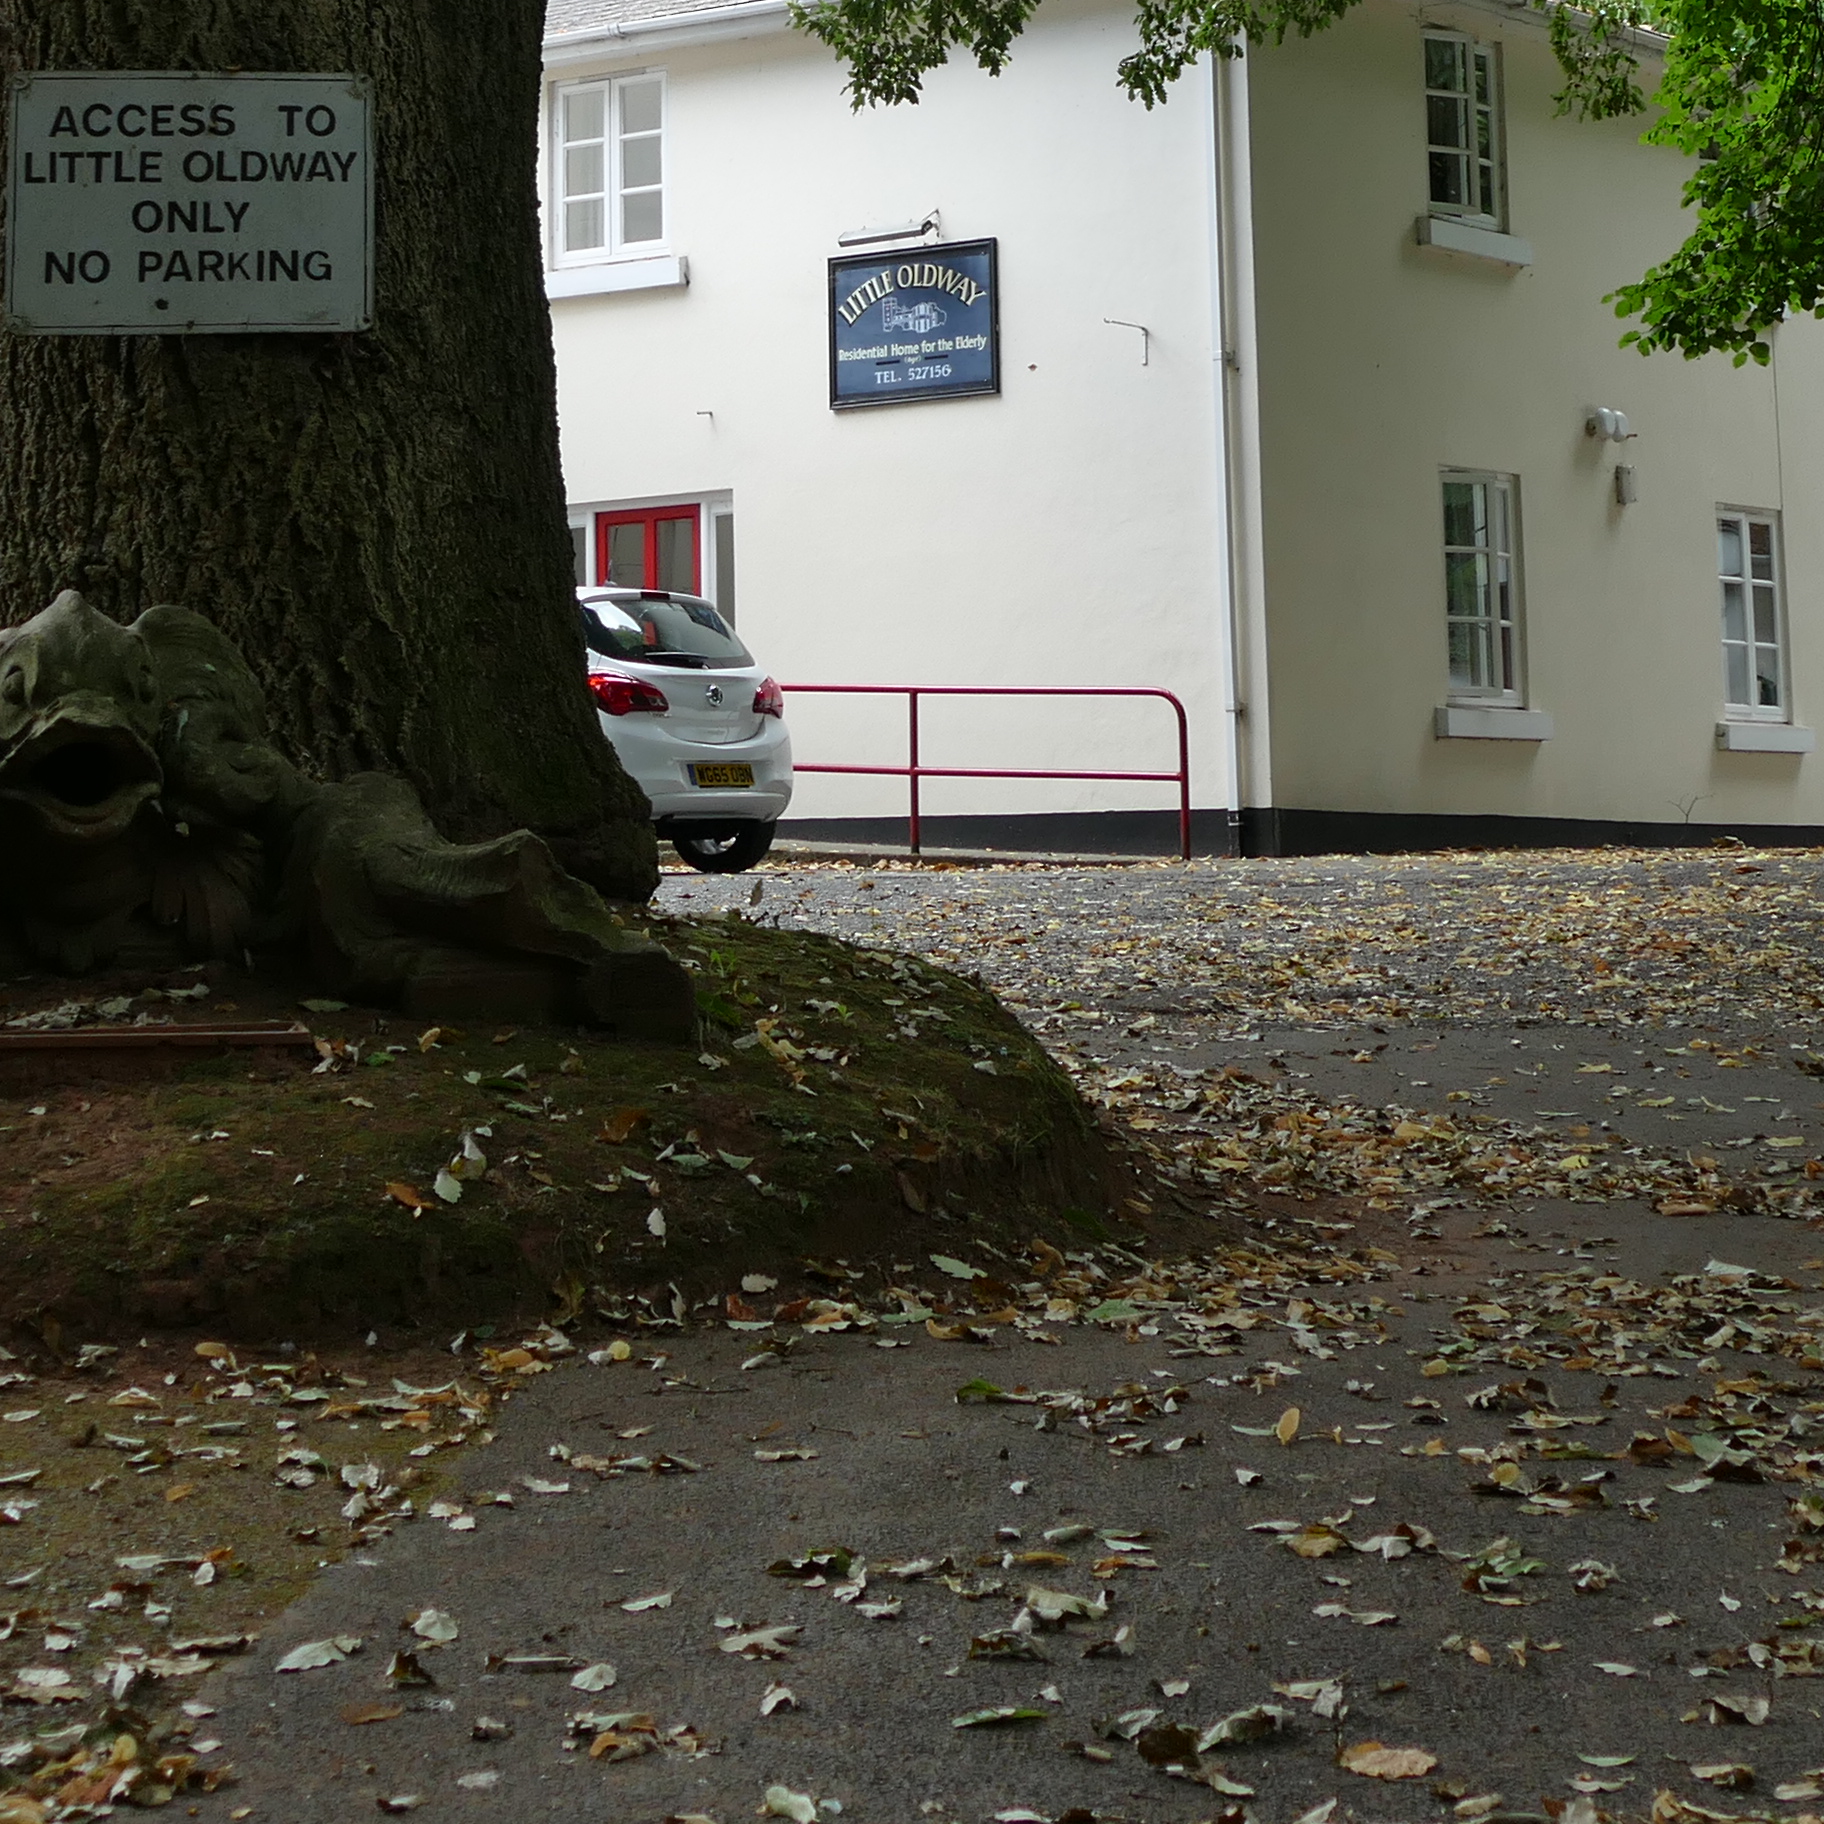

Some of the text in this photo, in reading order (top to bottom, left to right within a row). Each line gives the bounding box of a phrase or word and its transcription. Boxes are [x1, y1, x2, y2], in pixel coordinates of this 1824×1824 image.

[49, 104, 337, 138] ACCESS TO
[24, 150, 358, 184] LITTLE OLDWAY
[131, 200, 250, 234] ONLY
[44, 249, 333, 285] NO PARKING
[838, 263, 988, 326] LITTLE OLDWAY
[838, 344, 888, 362] Residential
[891, 342, 919, 356] Home
[921, 339, 936, 354] for
[937, 338, 953, 352] the
[955, 334, 987, 351] Elderly
[874, 364, 952, 385] TEL. 527156
[697, 766, 729, 783] WG65
